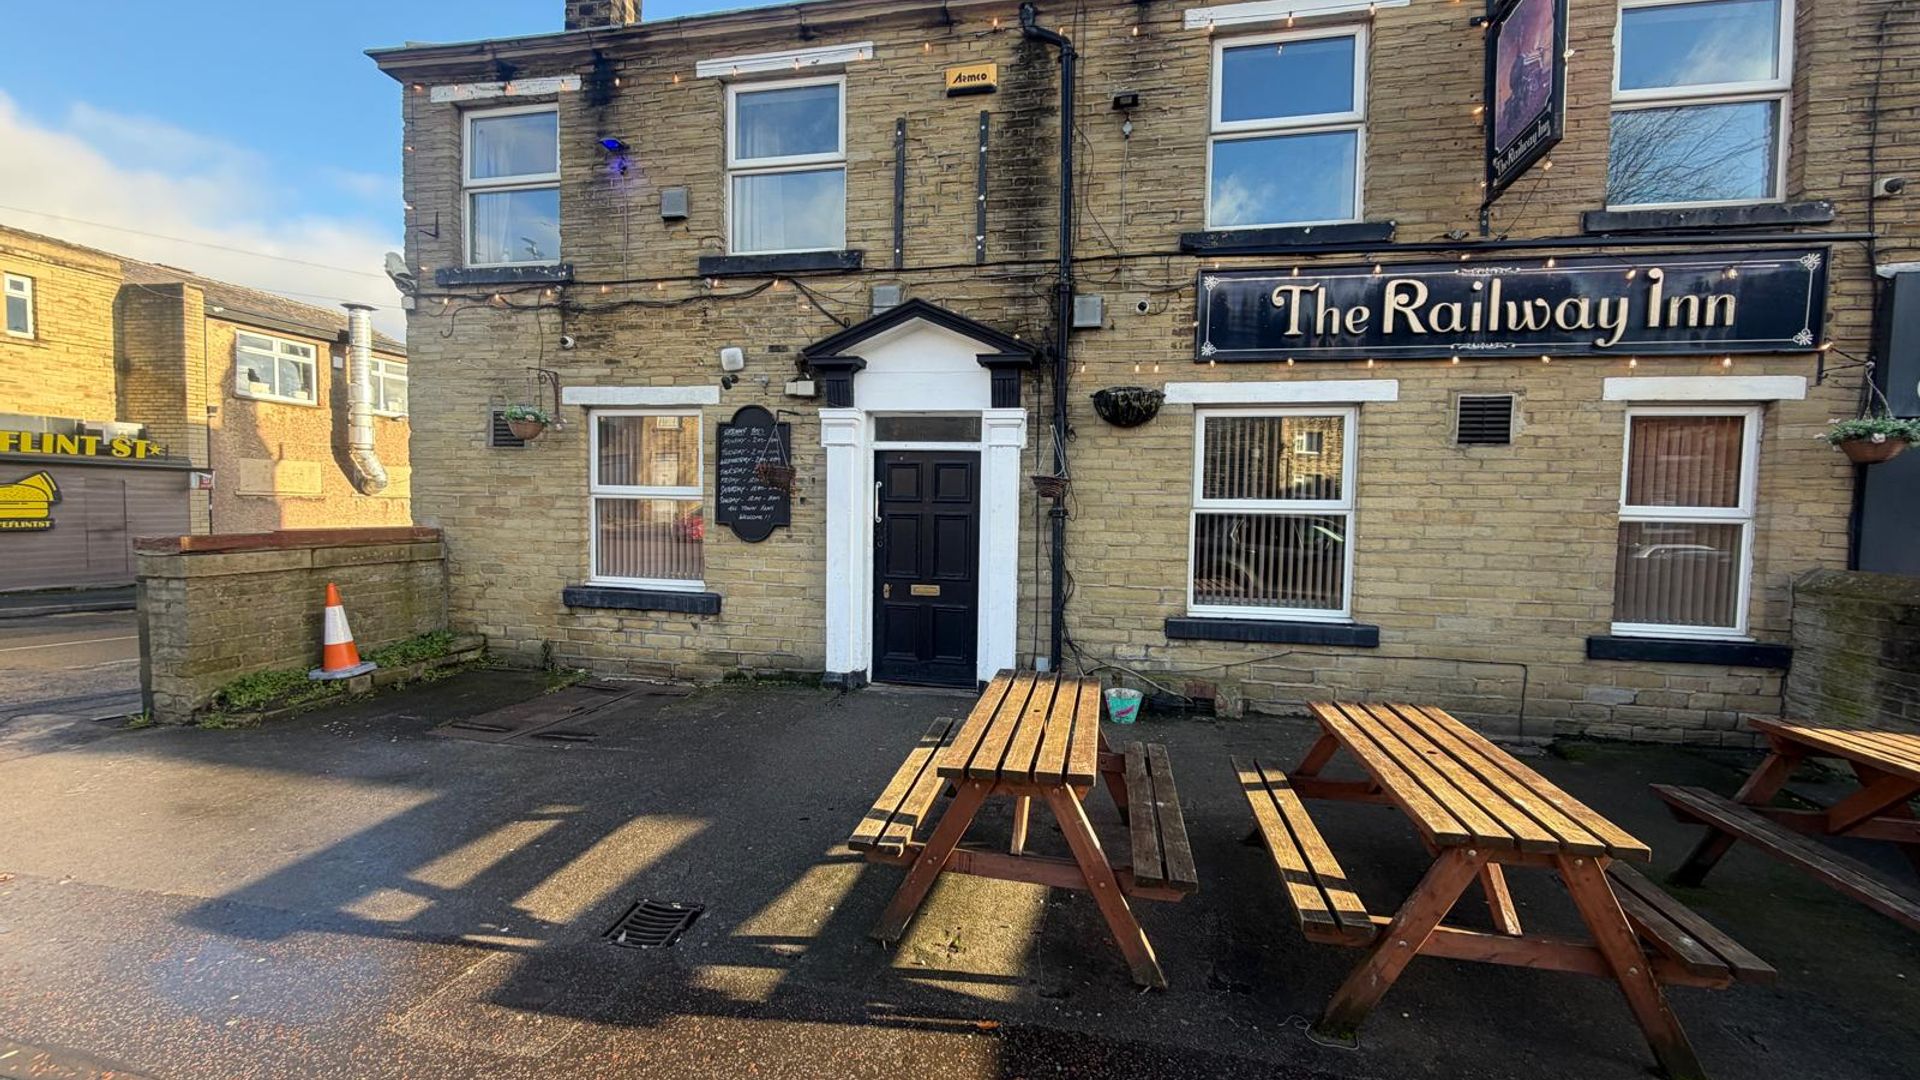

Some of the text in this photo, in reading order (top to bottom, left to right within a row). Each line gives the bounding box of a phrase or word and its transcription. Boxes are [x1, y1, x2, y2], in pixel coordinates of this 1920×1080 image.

[1508, 132, 1537, 166] Railway
[1272, 267, 1736, 347] The Railway Inn
[0, 431, 102, 456] FLINT
